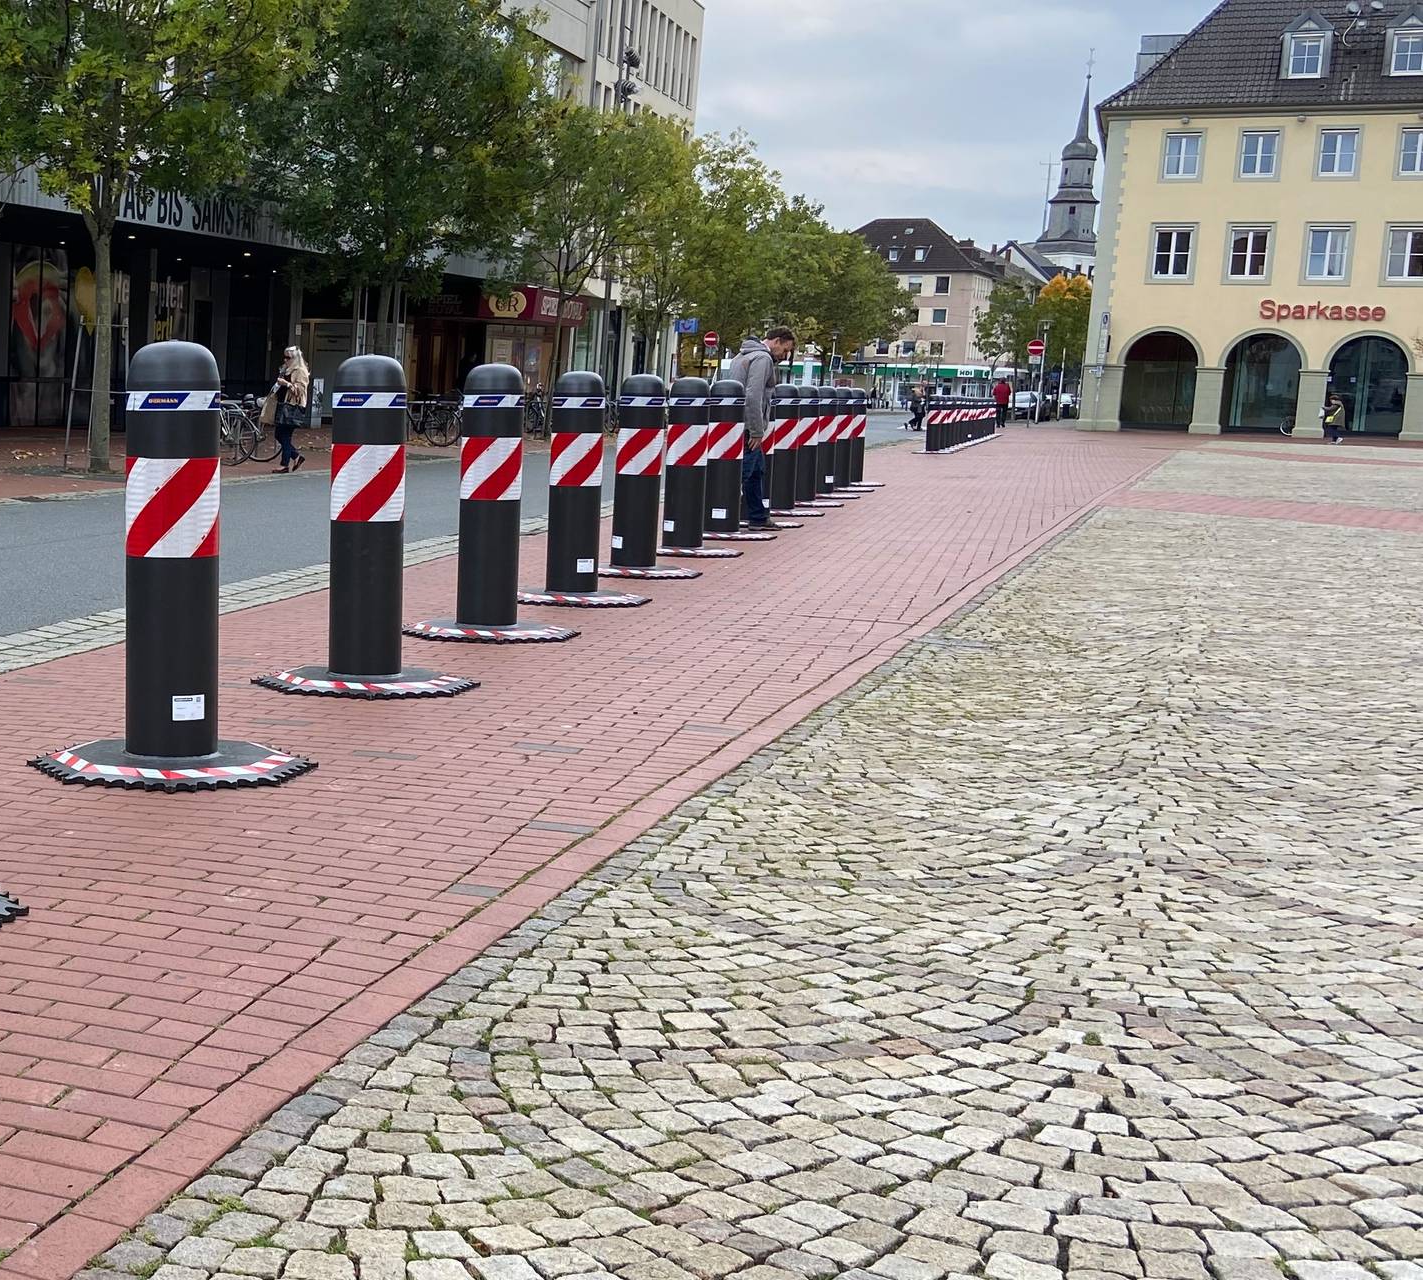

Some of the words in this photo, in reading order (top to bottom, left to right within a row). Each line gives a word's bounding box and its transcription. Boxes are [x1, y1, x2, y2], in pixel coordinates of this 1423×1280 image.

[157, 188, 183, 227] BIS
[192, 197, 260, 241] SAMSTA
[1259, 299, 1386, 322] Sparkasse
